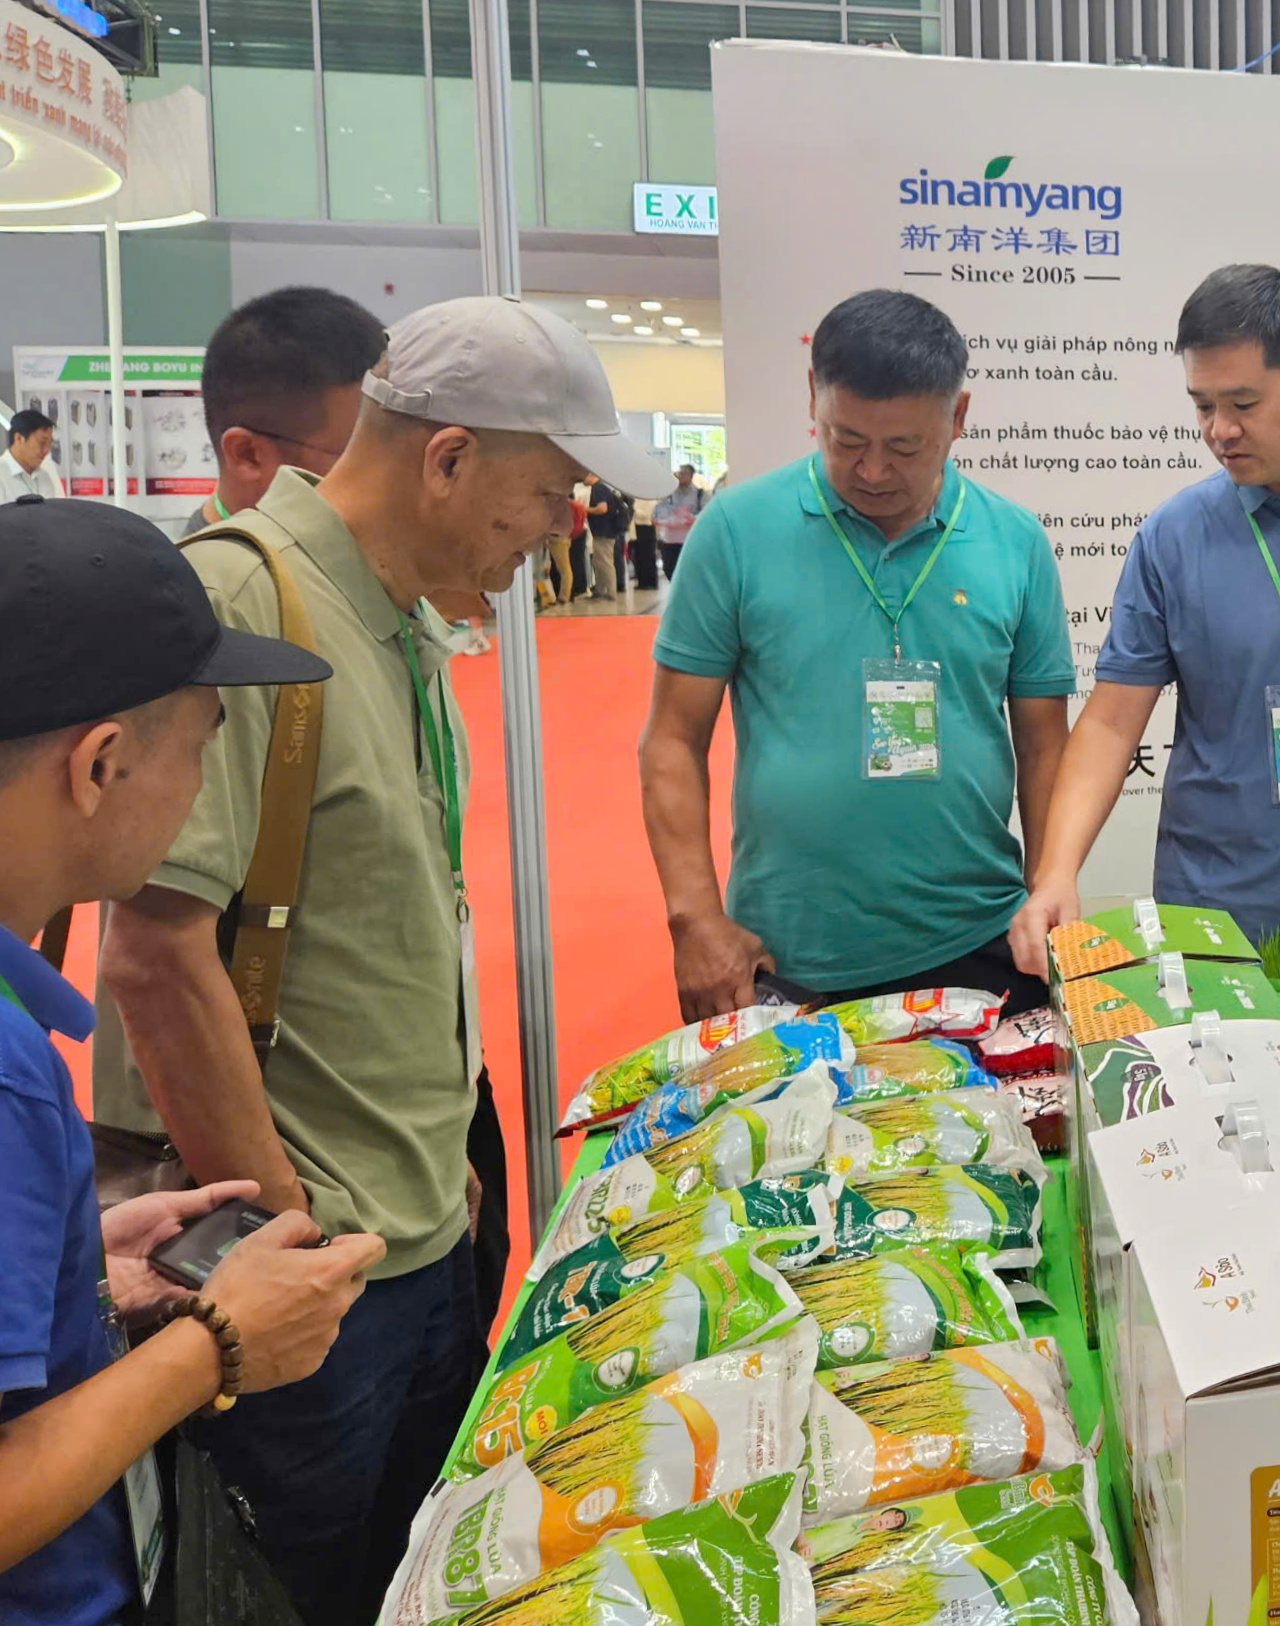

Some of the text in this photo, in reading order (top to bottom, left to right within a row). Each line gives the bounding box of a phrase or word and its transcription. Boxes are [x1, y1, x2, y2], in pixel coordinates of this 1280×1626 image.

[645, 192, 716, 220] EXI
[899, 168, 1122, 220] sinamyang
[900, 223, 1121, 256] 新南洋集团
[951, 263, 1076, 284] Since 2005
[995, 337, 1019, 355] vụ
[1023, 333, 1057, 355] giải
[1062, 335, 1108, 356] pháp
[1112, 336, 1158, 356] nông
[984, 364, 1030, 381] xanh
[1034, 365, 1075, 381] toàn
[1080, 362, 1118, 382] cầu.
[997, 420, 1048, 444] phẩm
[1052, 421, 1105, 441] thuốc
[1110, 424, 1144, 441] bảo
[1147, 424, 1169, 444] vệ
[978, 450, 1019, 470] chất
[1024, 453, 1080, 474] lượng
[1084, 457, 1118, 470] cao
[1121, 453, 1162, 470] toàn
[1166, 450, 1203, 470] cầu.
